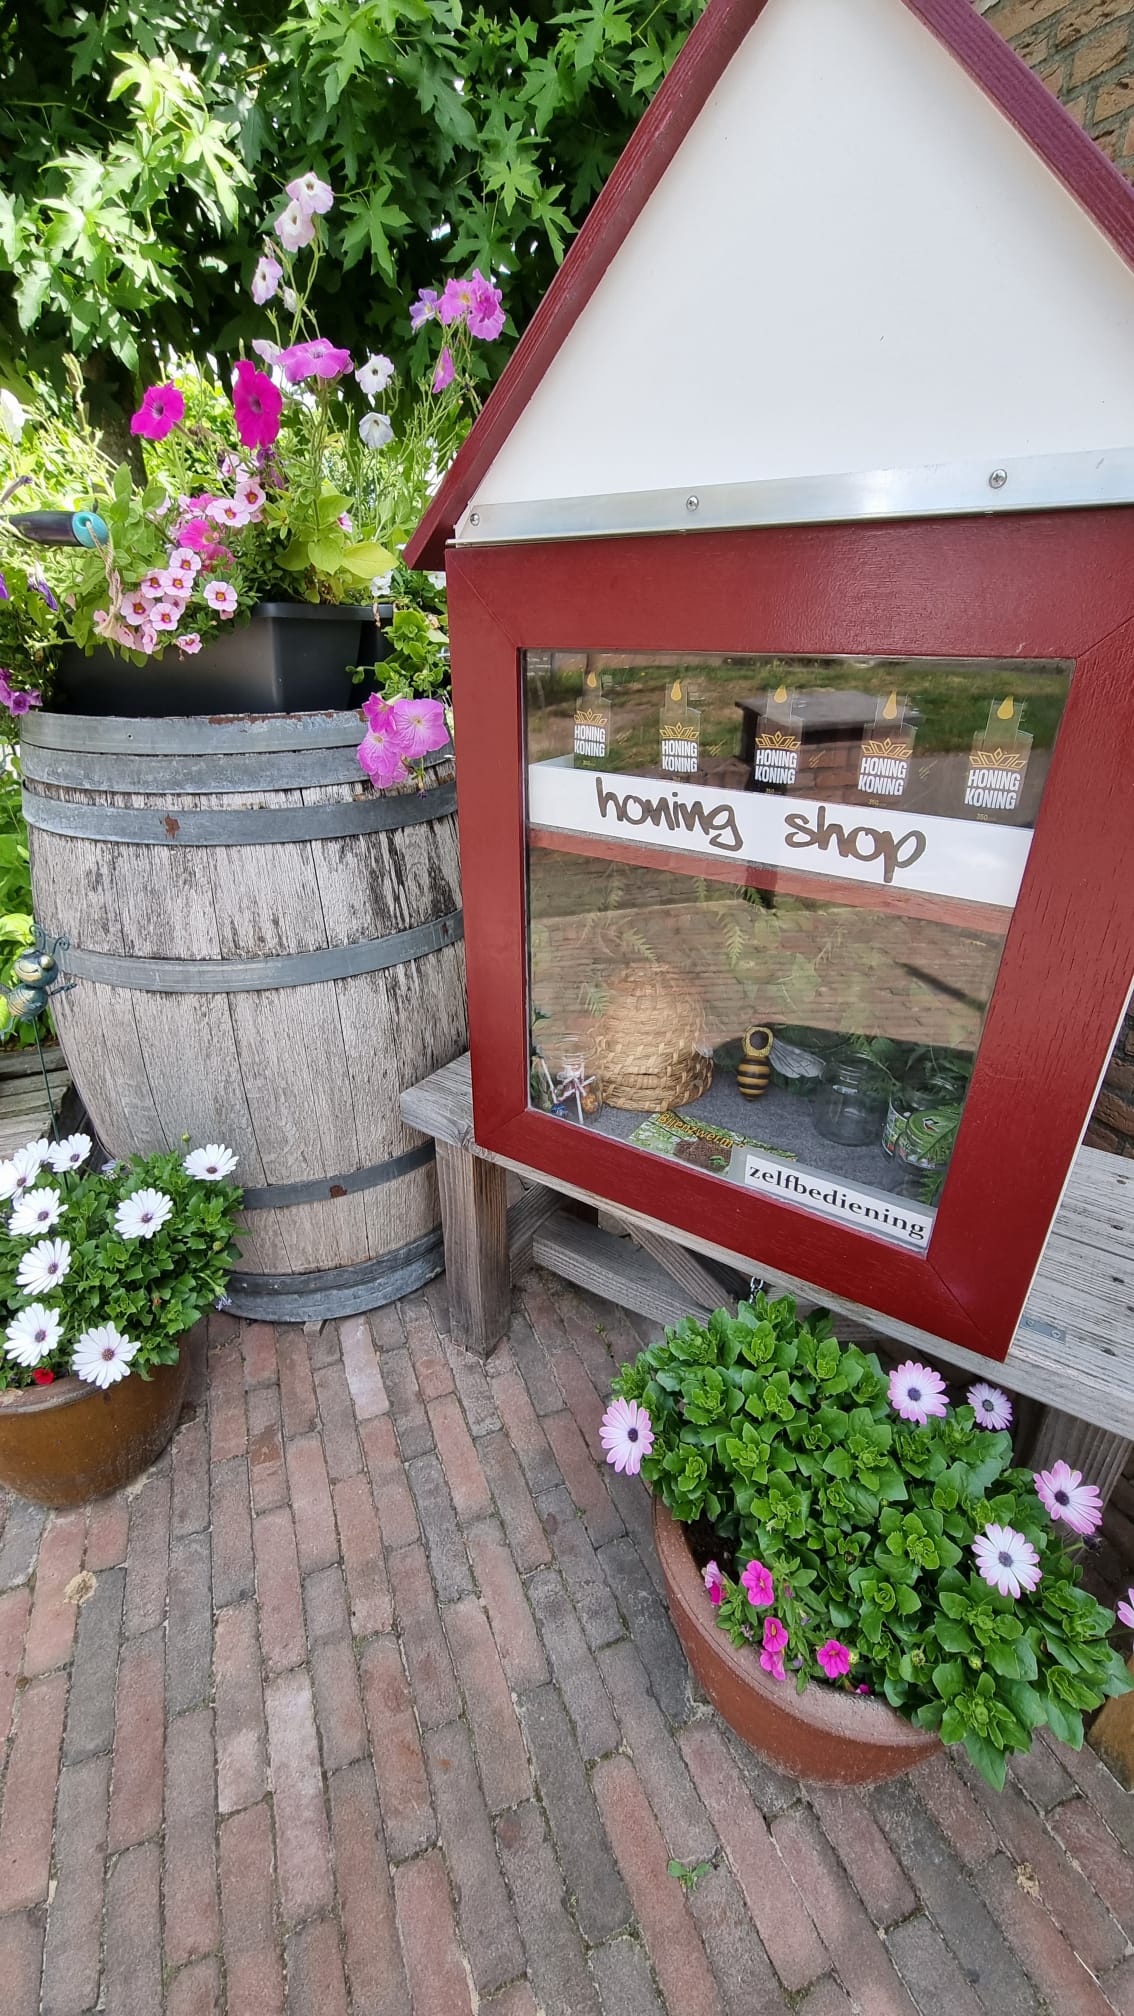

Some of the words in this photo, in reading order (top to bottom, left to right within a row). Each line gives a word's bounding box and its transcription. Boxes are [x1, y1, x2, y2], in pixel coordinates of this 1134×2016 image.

[574, 725, 606, 742] HONING
[574, 740, 606, 757] KONING
[661, 740, 698, 757] HONING
[756, 749, 798, 768] HONING
[661, 756, 698, 773] KONING
[860, 757, 908, 778] HONING
[754, 766, 796, 784] KONING
[967, 769, 1021, 791] HONING
[858, 775, 905, 796] KONING
[964, 787, 1017, 810] KONING
[595, 776, 745, 852] honing
[784, 805, 927, 883] shop
[749, 1165, 927, 1240] zelfbediening
